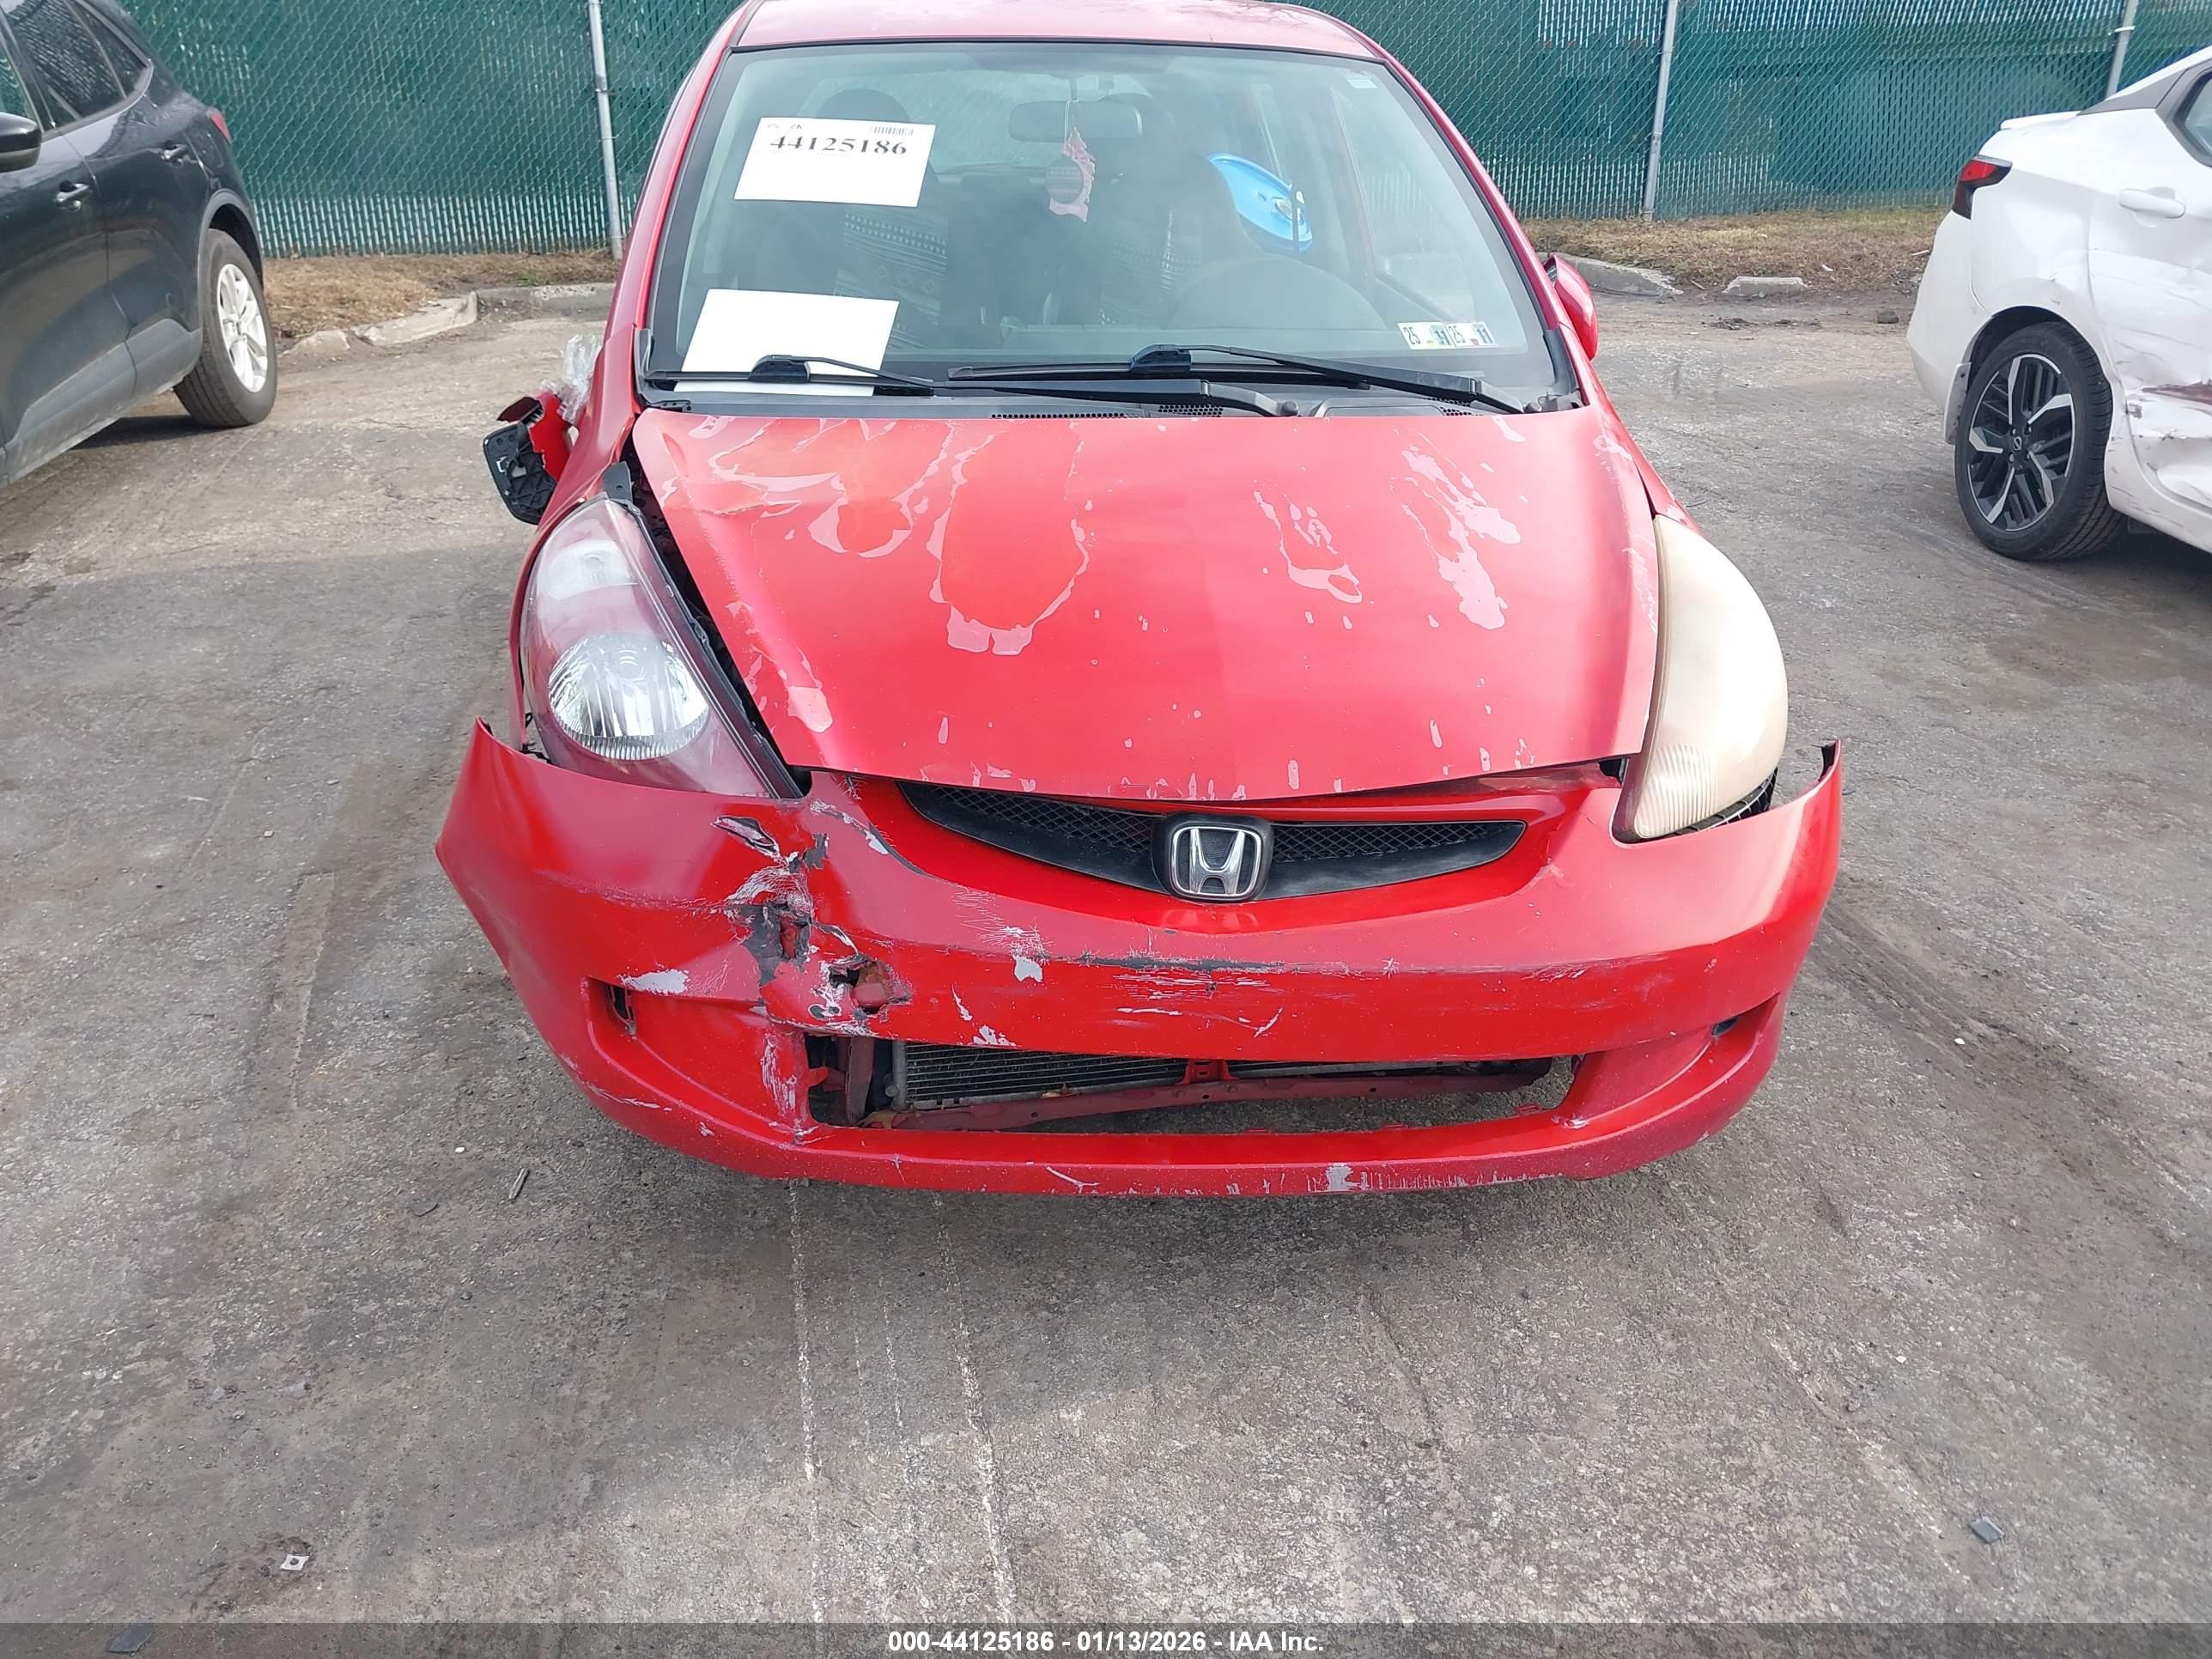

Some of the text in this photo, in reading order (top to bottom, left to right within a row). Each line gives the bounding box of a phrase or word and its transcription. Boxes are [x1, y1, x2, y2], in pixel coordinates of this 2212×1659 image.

[769, 136, 908, 155] 44125186
[1403, 326, 1421, 345] 25
[1448, 325, 1466, 343] 25
